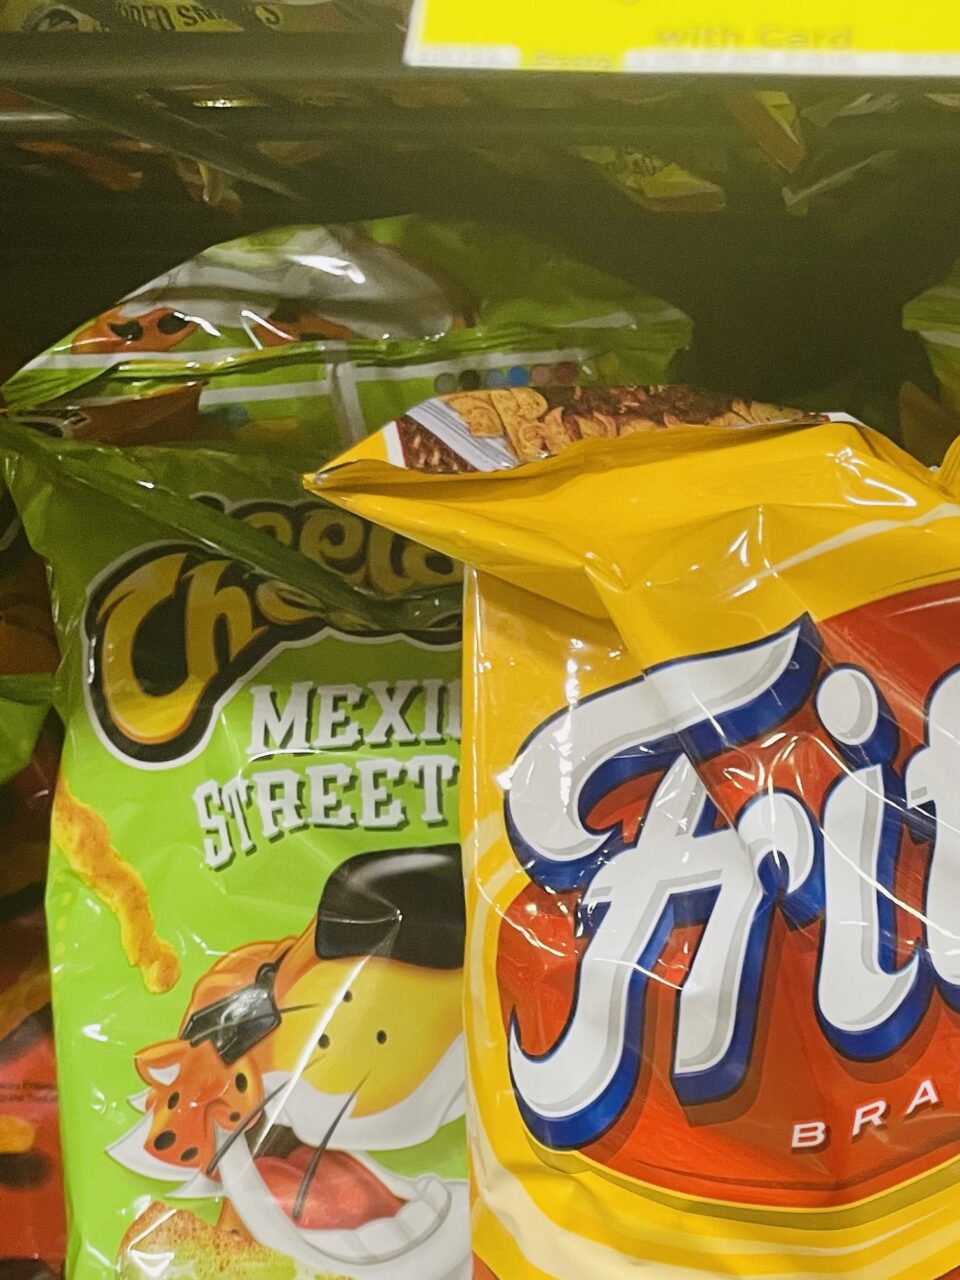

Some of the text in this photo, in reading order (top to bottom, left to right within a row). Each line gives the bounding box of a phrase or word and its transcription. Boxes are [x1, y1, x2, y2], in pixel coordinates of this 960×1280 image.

[758, 23, 854, 50] Card
[246, 677, 462, 762] MEXI
[192, 754, 460, 871] STREET
